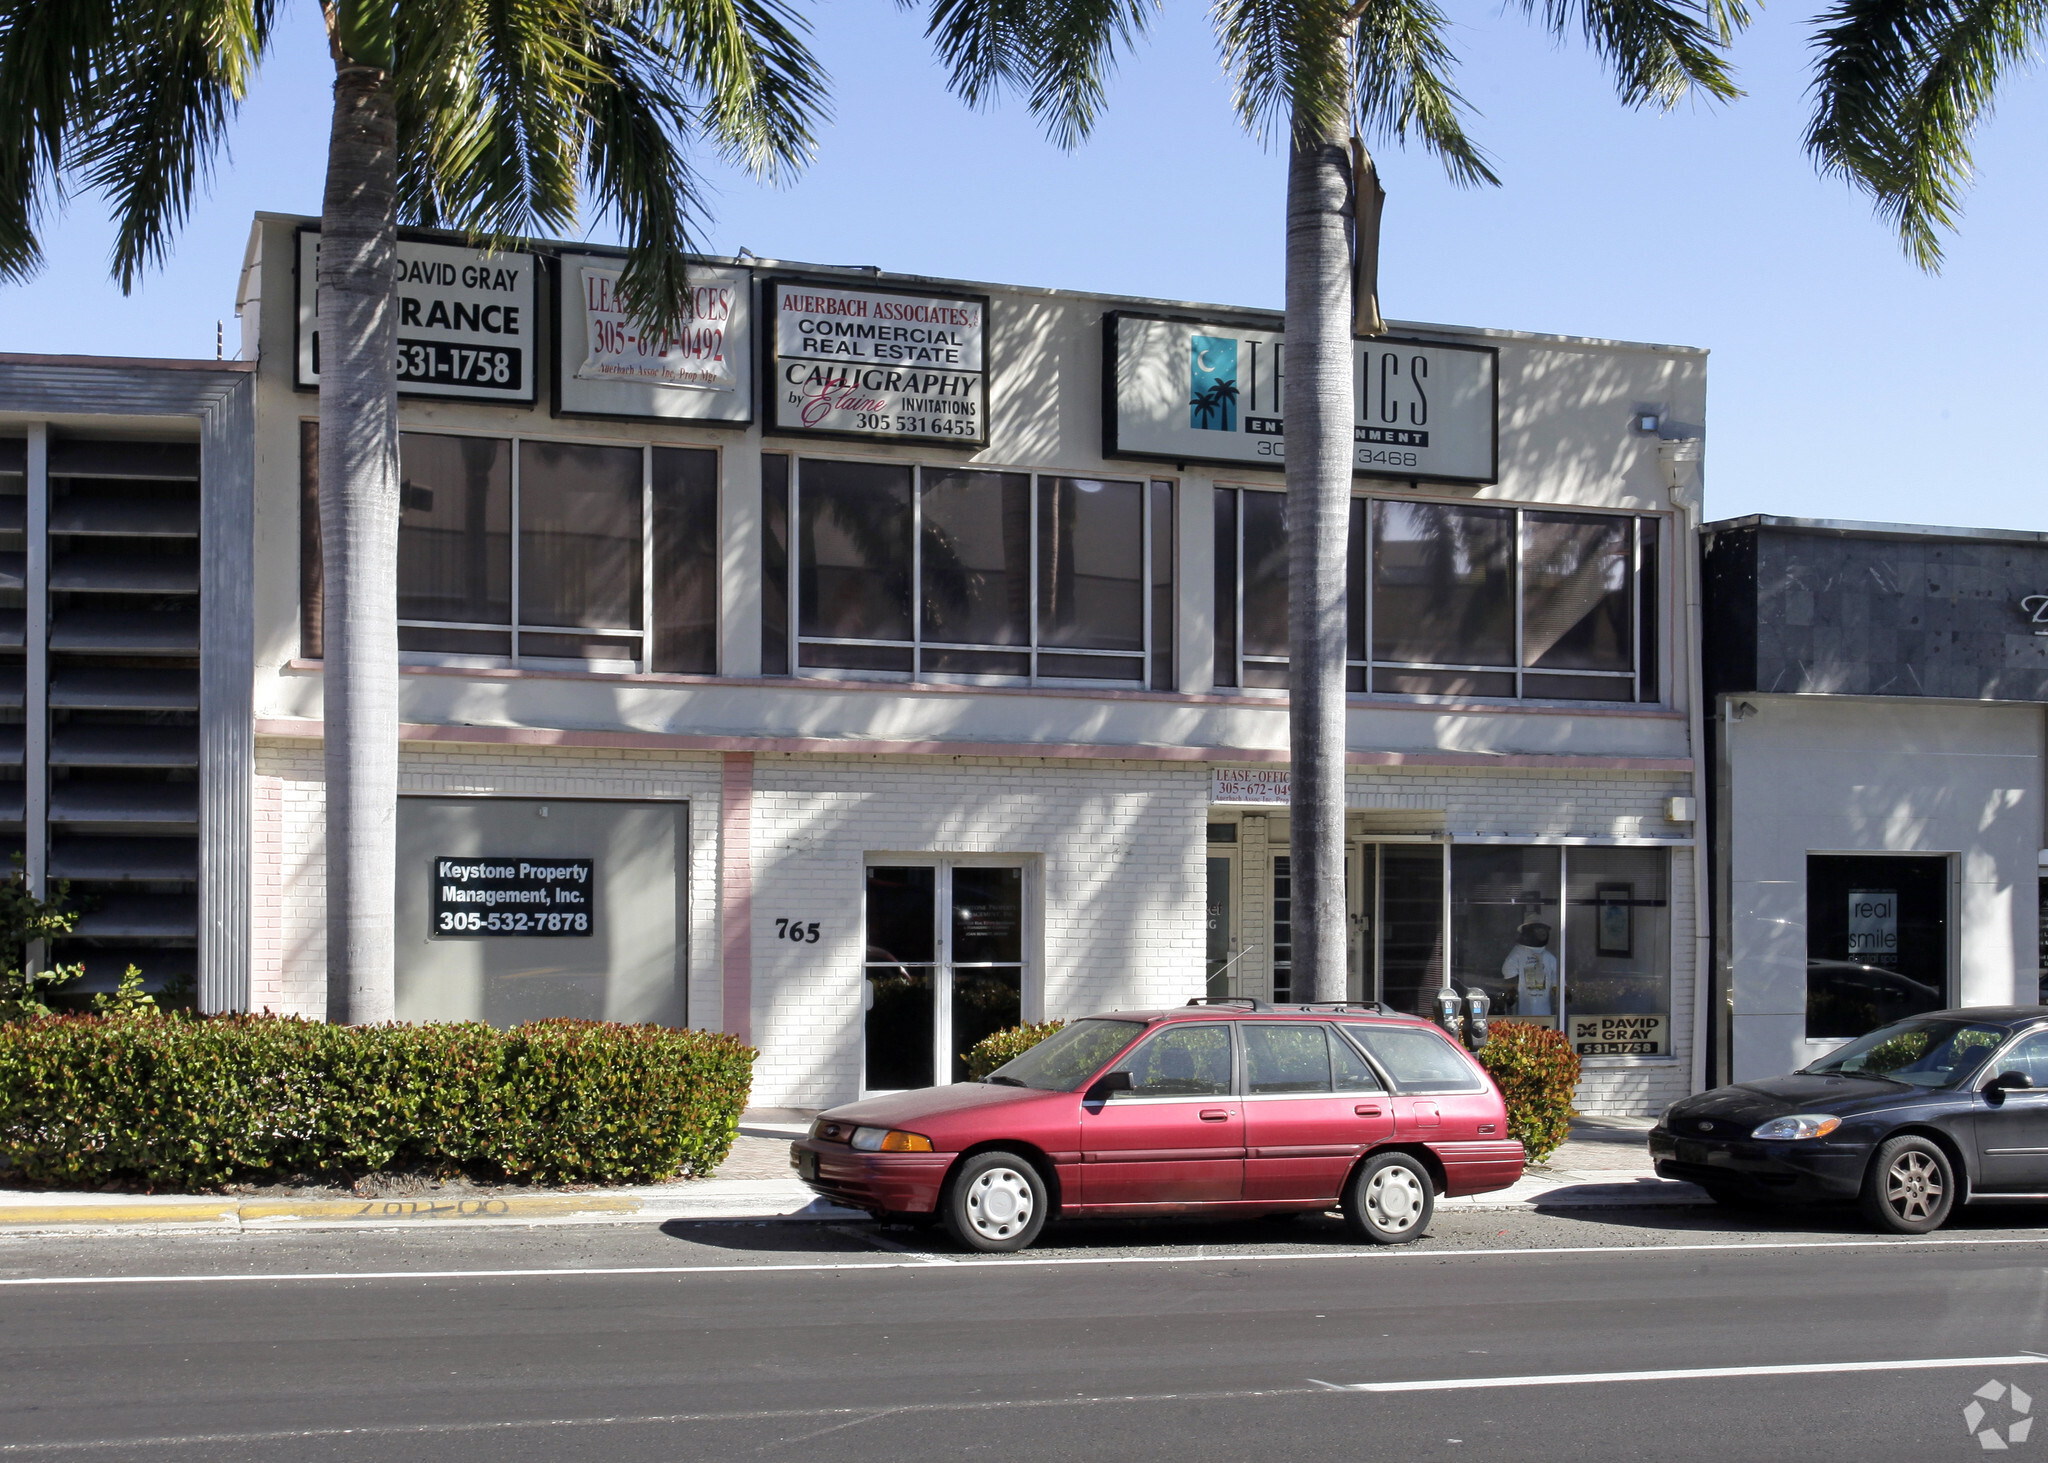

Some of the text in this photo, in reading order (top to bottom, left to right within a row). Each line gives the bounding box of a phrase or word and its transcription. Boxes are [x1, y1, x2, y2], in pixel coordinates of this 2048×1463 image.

[397, 258, 519, 292] DAVID GRAY
[397, 296, 520, 336] RANCE
[782, 294, 972, 328] AUERBACH ASSOCIATES,
[798, 319, 963, 346] COMMERCIAL
[803, 337, 959, 364] REAL ESTATE
[600, 362, 635, 375] Auerbach
[639, 365, 659, 377] Assoc
[680, 368, 698, 382] Prop
[701, 369, 717, 383] Mgr
[785, 363, 977, 397] CALLIGRAPHY
[1245, 340, 1428, 426] TICS
[788, 376, 887, 429] by Elaine
[902, 397, 976, 416] INVITATIONS
[856, 412, 976, 436] 305 531 6455
[1252, 420, 1422, 444] ENNMENT
[1358, 448, 1418, 467] 3468
[439, 861, 588, 883] Keystone Property
[442, 885, 585, 906] Management, Inc.
[1855, 898, 1891, 918] real
[440, 912, 588, 931] 305-532-7878
[775, 917, 821, 944] 765
[1849, 928, 1897, 948] smile
[1602, 1018, 1659, 1029] DAVID
[1602, 1029, 1652, 1040] GRAY
[1584, 1043, 1652, 1053] 531-1758
